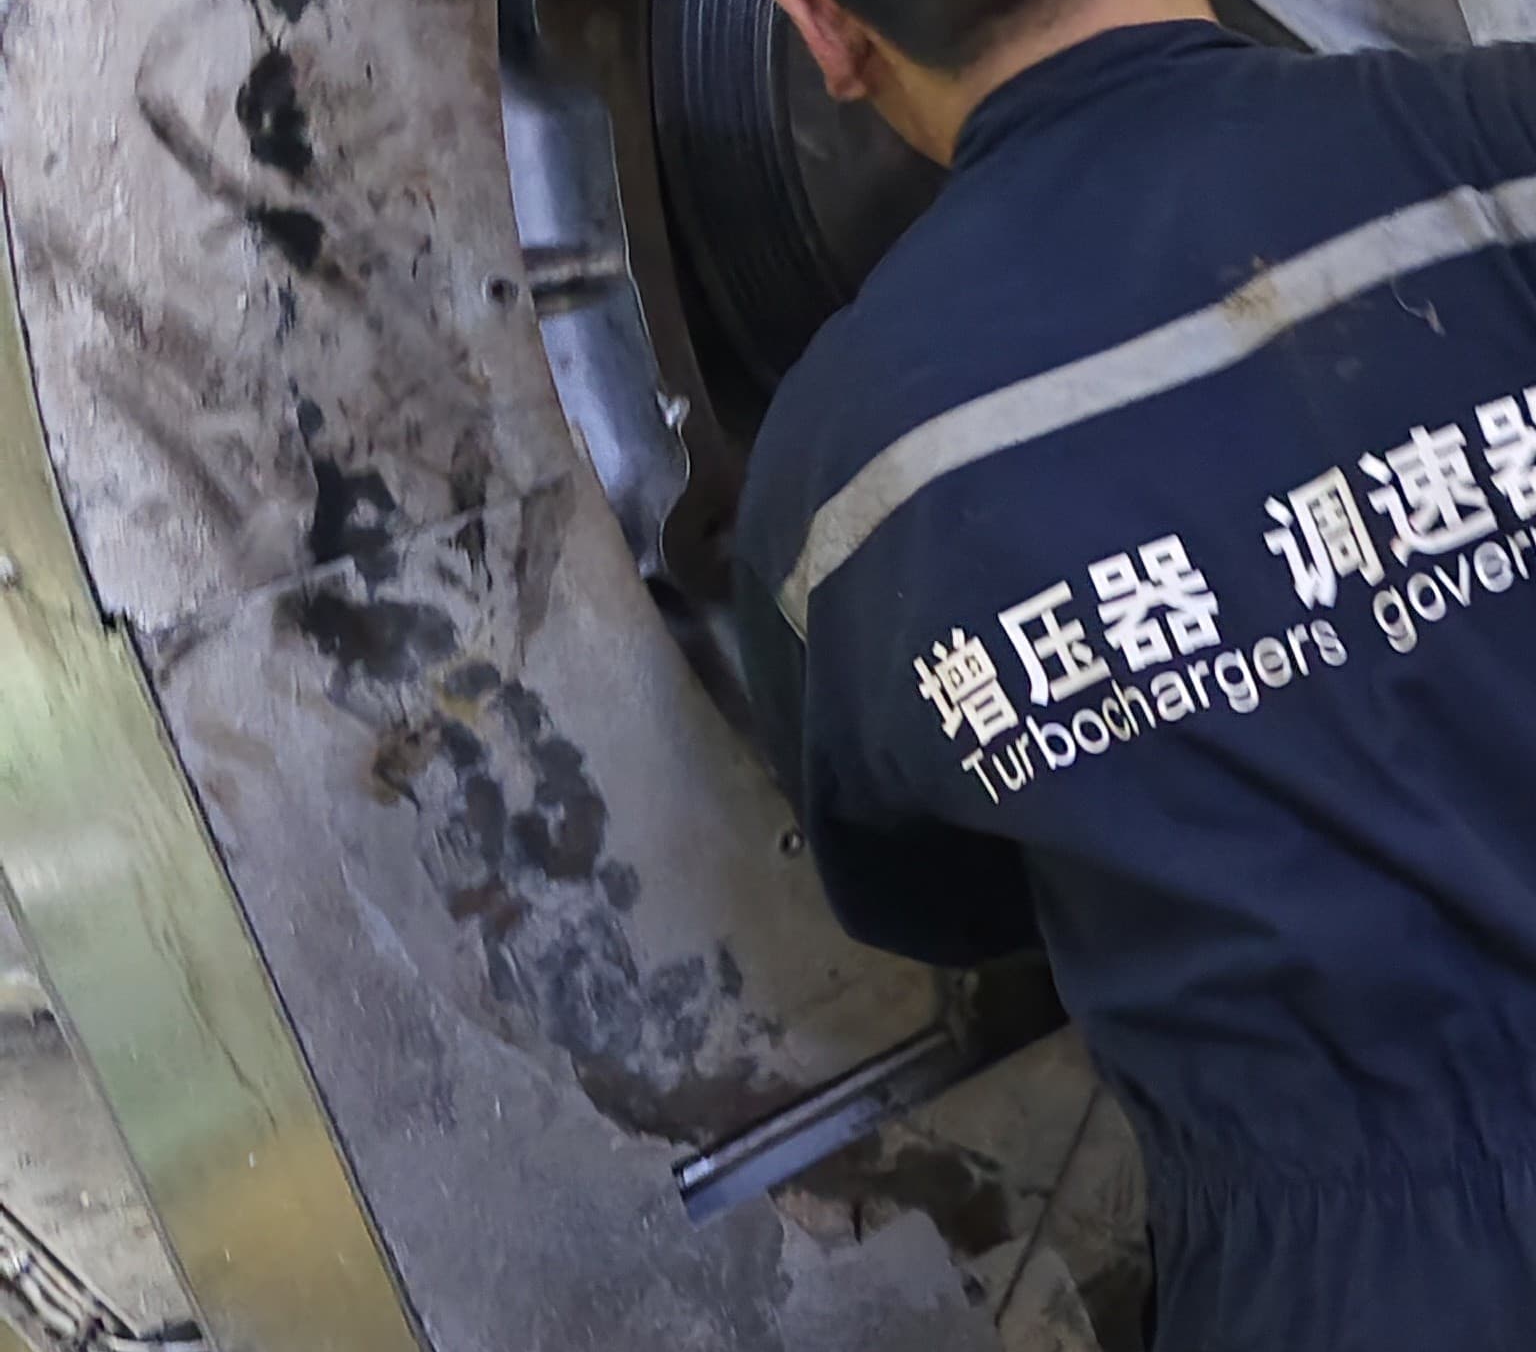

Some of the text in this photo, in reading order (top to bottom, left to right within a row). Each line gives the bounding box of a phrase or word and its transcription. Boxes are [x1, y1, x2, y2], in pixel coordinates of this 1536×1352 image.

[913, 533, 1221, 747] 增压器
[961, 619, 1348, 805] Turbochargers
